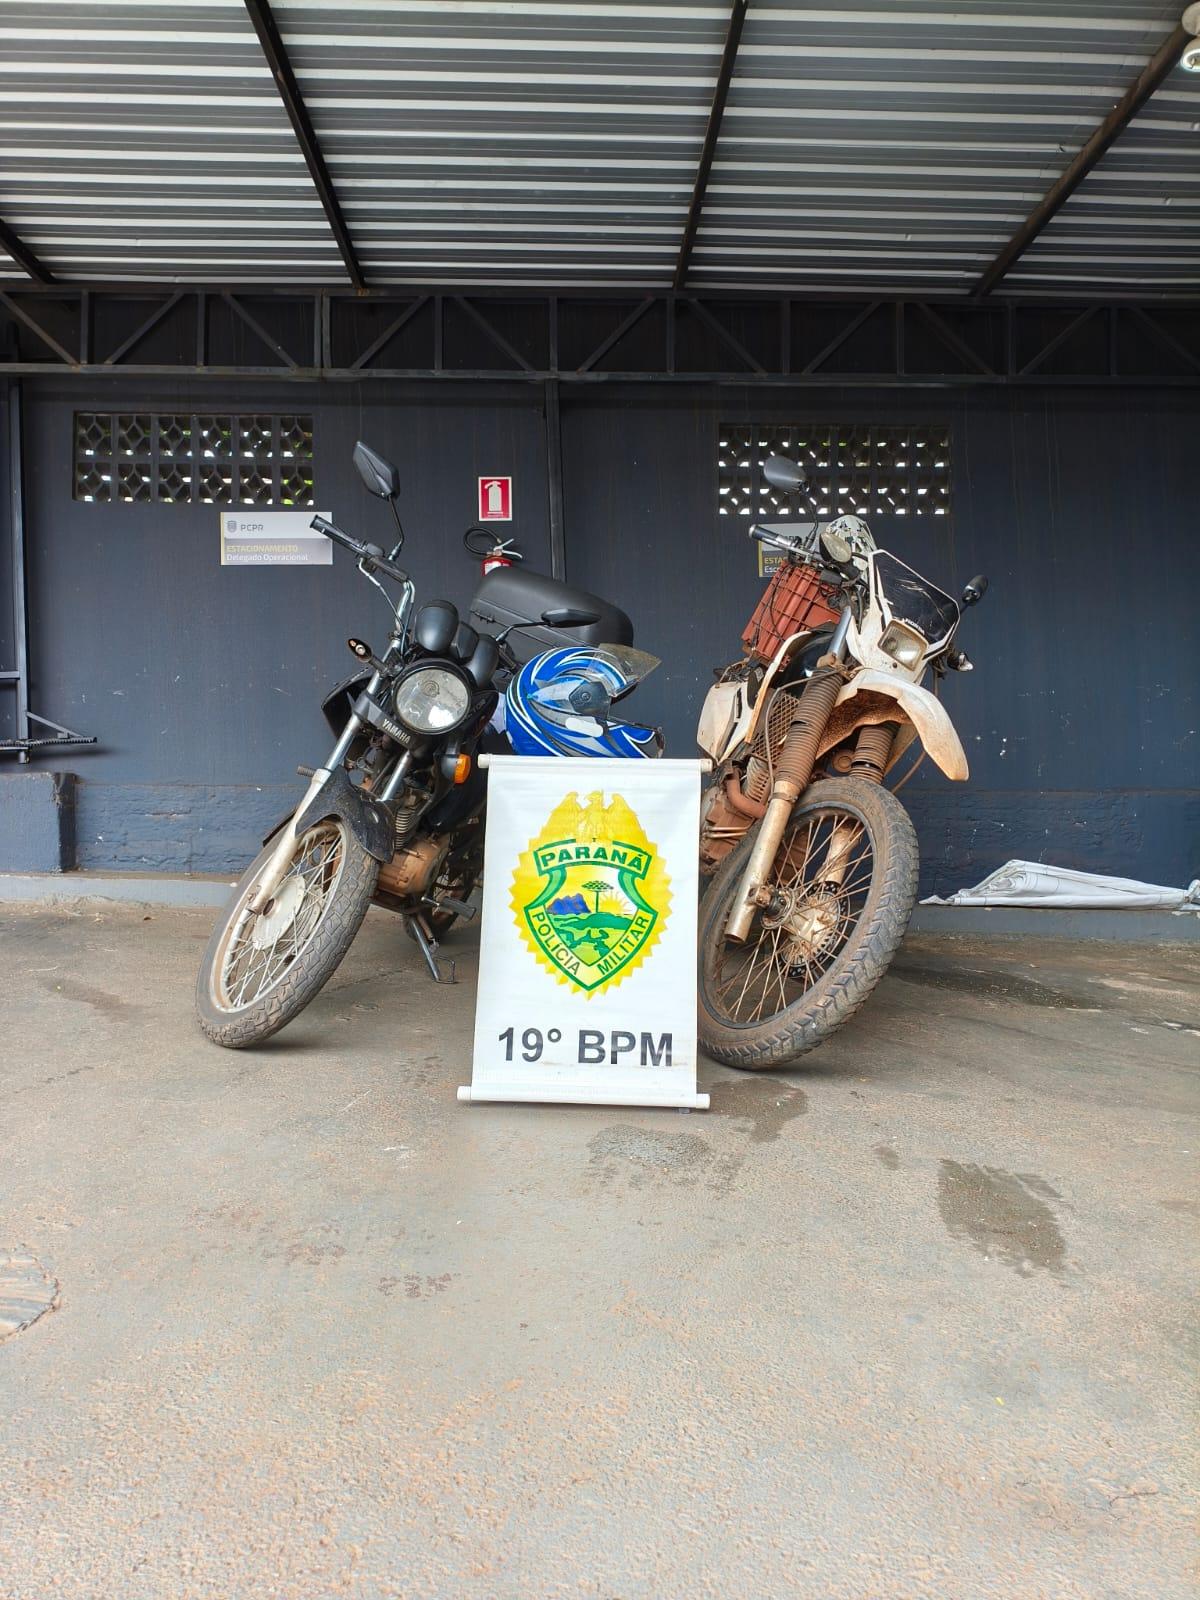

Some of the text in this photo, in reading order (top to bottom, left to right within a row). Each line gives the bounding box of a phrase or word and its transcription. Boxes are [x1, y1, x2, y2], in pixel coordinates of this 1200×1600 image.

[240, 524, 264, 532] PCPR
[226, 545, 298, 554] ESTACIONAMENTO
[226, 553, 308, 562] Delegado Operacional
[382, 719, 411, 744] YAMAHA
[540, 846, 644, 872] PARANÁ
[532, 912, 650, 976] POLÍCIA MILITAR
[577, 1029, 673, 1067] BPM
